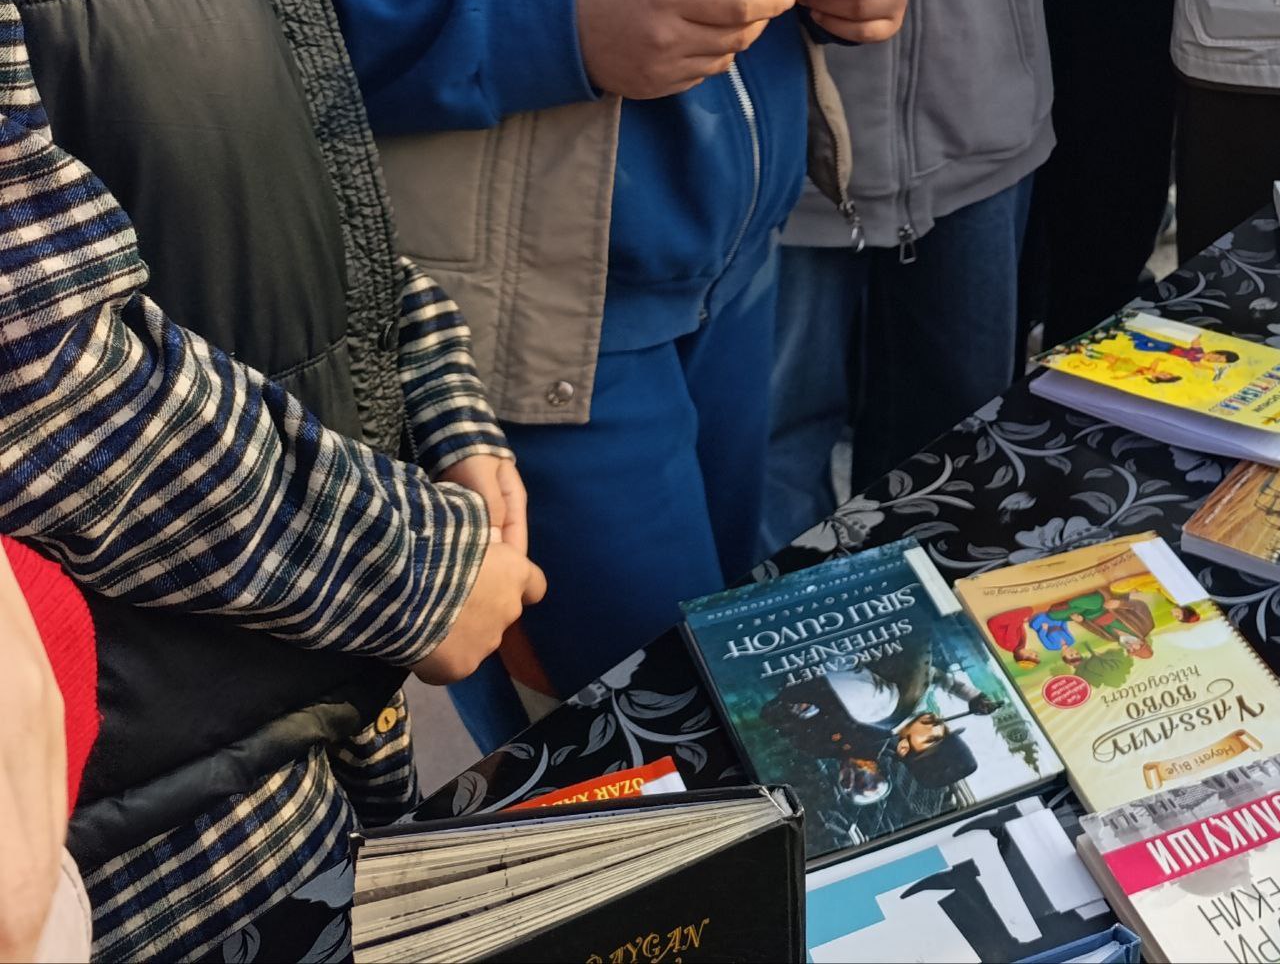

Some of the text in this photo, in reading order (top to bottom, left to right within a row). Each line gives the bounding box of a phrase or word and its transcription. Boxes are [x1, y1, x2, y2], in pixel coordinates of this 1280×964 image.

[722, 584, 918, 659] SIRLI GUVOH
[751, 583, 873, 628] HIKOYALAR
[760, 616, 913, 679] SHTEENFATT
[784, 638, 903, 686] MARGARET
[1100, 663, 1201, 707] hikoyalari
[1124, 682, 1197, 720] BOBO
[1092, 694, 1264, 761] YASSAVIY
[1164, 744, 1235, 775] Hayati Bije
